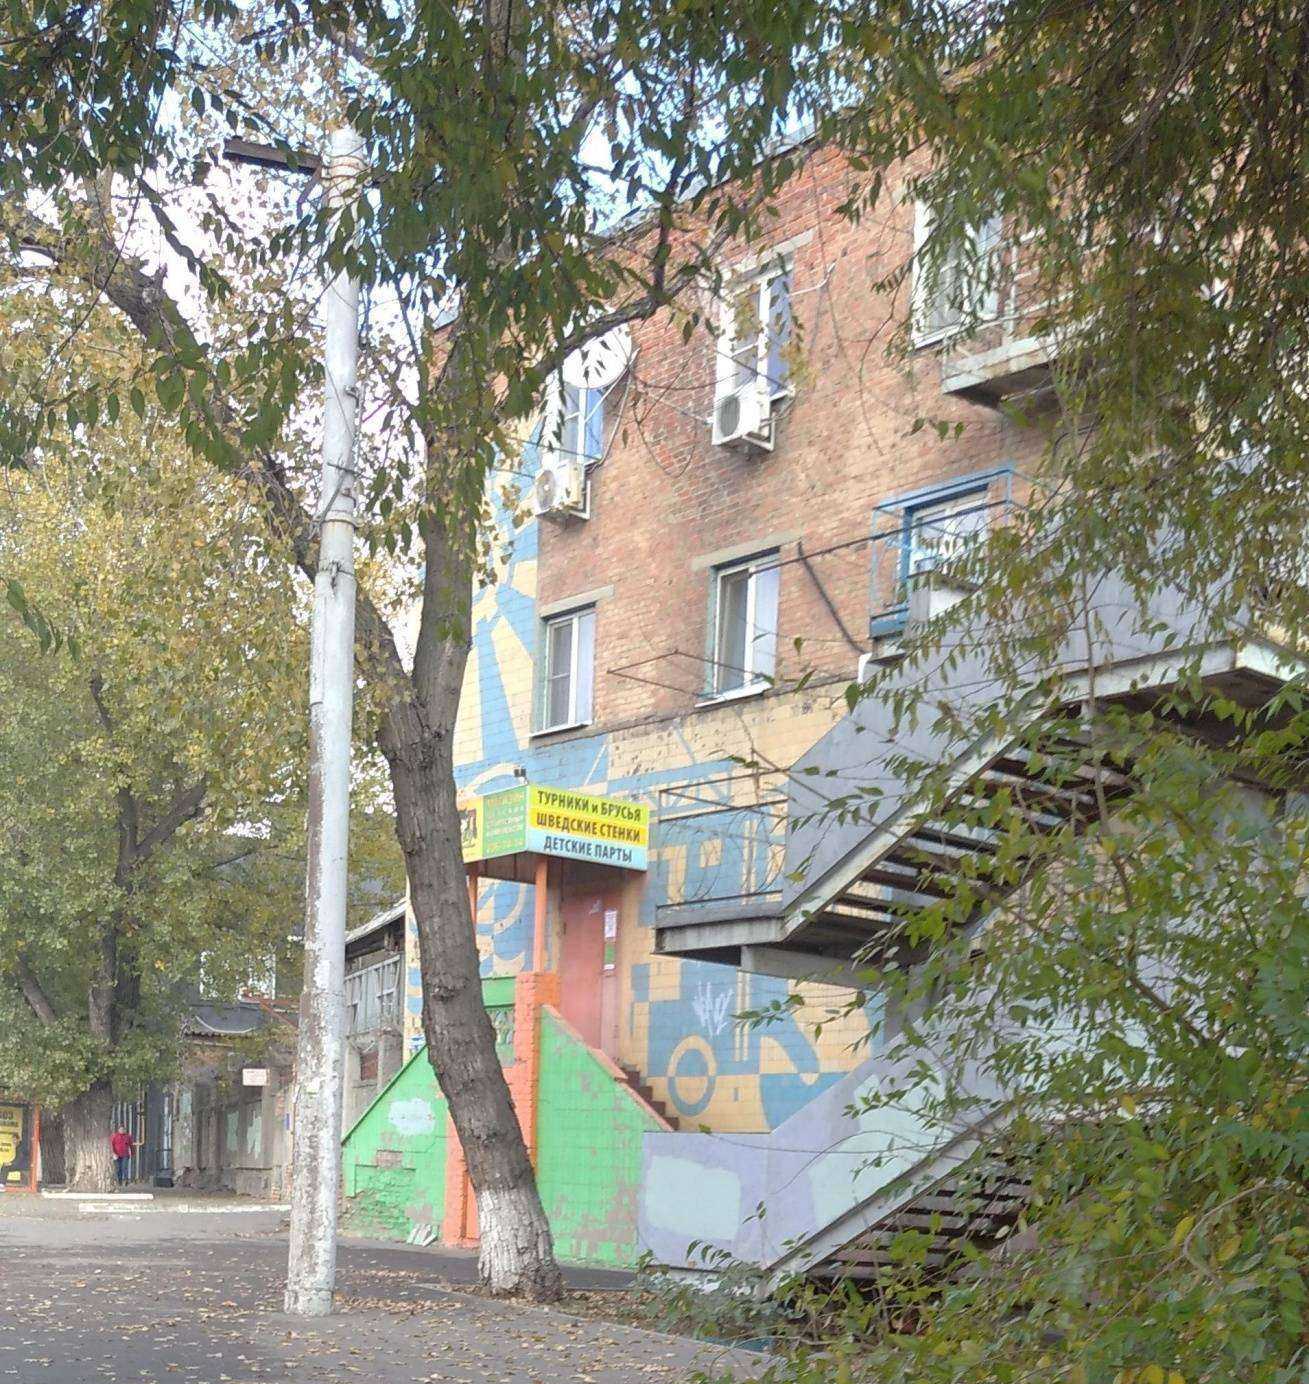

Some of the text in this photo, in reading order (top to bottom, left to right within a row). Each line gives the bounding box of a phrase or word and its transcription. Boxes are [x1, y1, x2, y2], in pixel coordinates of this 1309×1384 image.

[538, 790, 589, 812] ТУРНИКИ
[592, 805, 598, 813] и
[601, 802, 641, 822] БРУСЬЯ
[537, 812, 597, 835] ШВЕДСКИЕ
[600, 824, 640, 842] СТЕНКИ
[544, 836, 592, 856] ДЕТСКИЕ
[595, 844, 632, 862] ПАРТЫ
